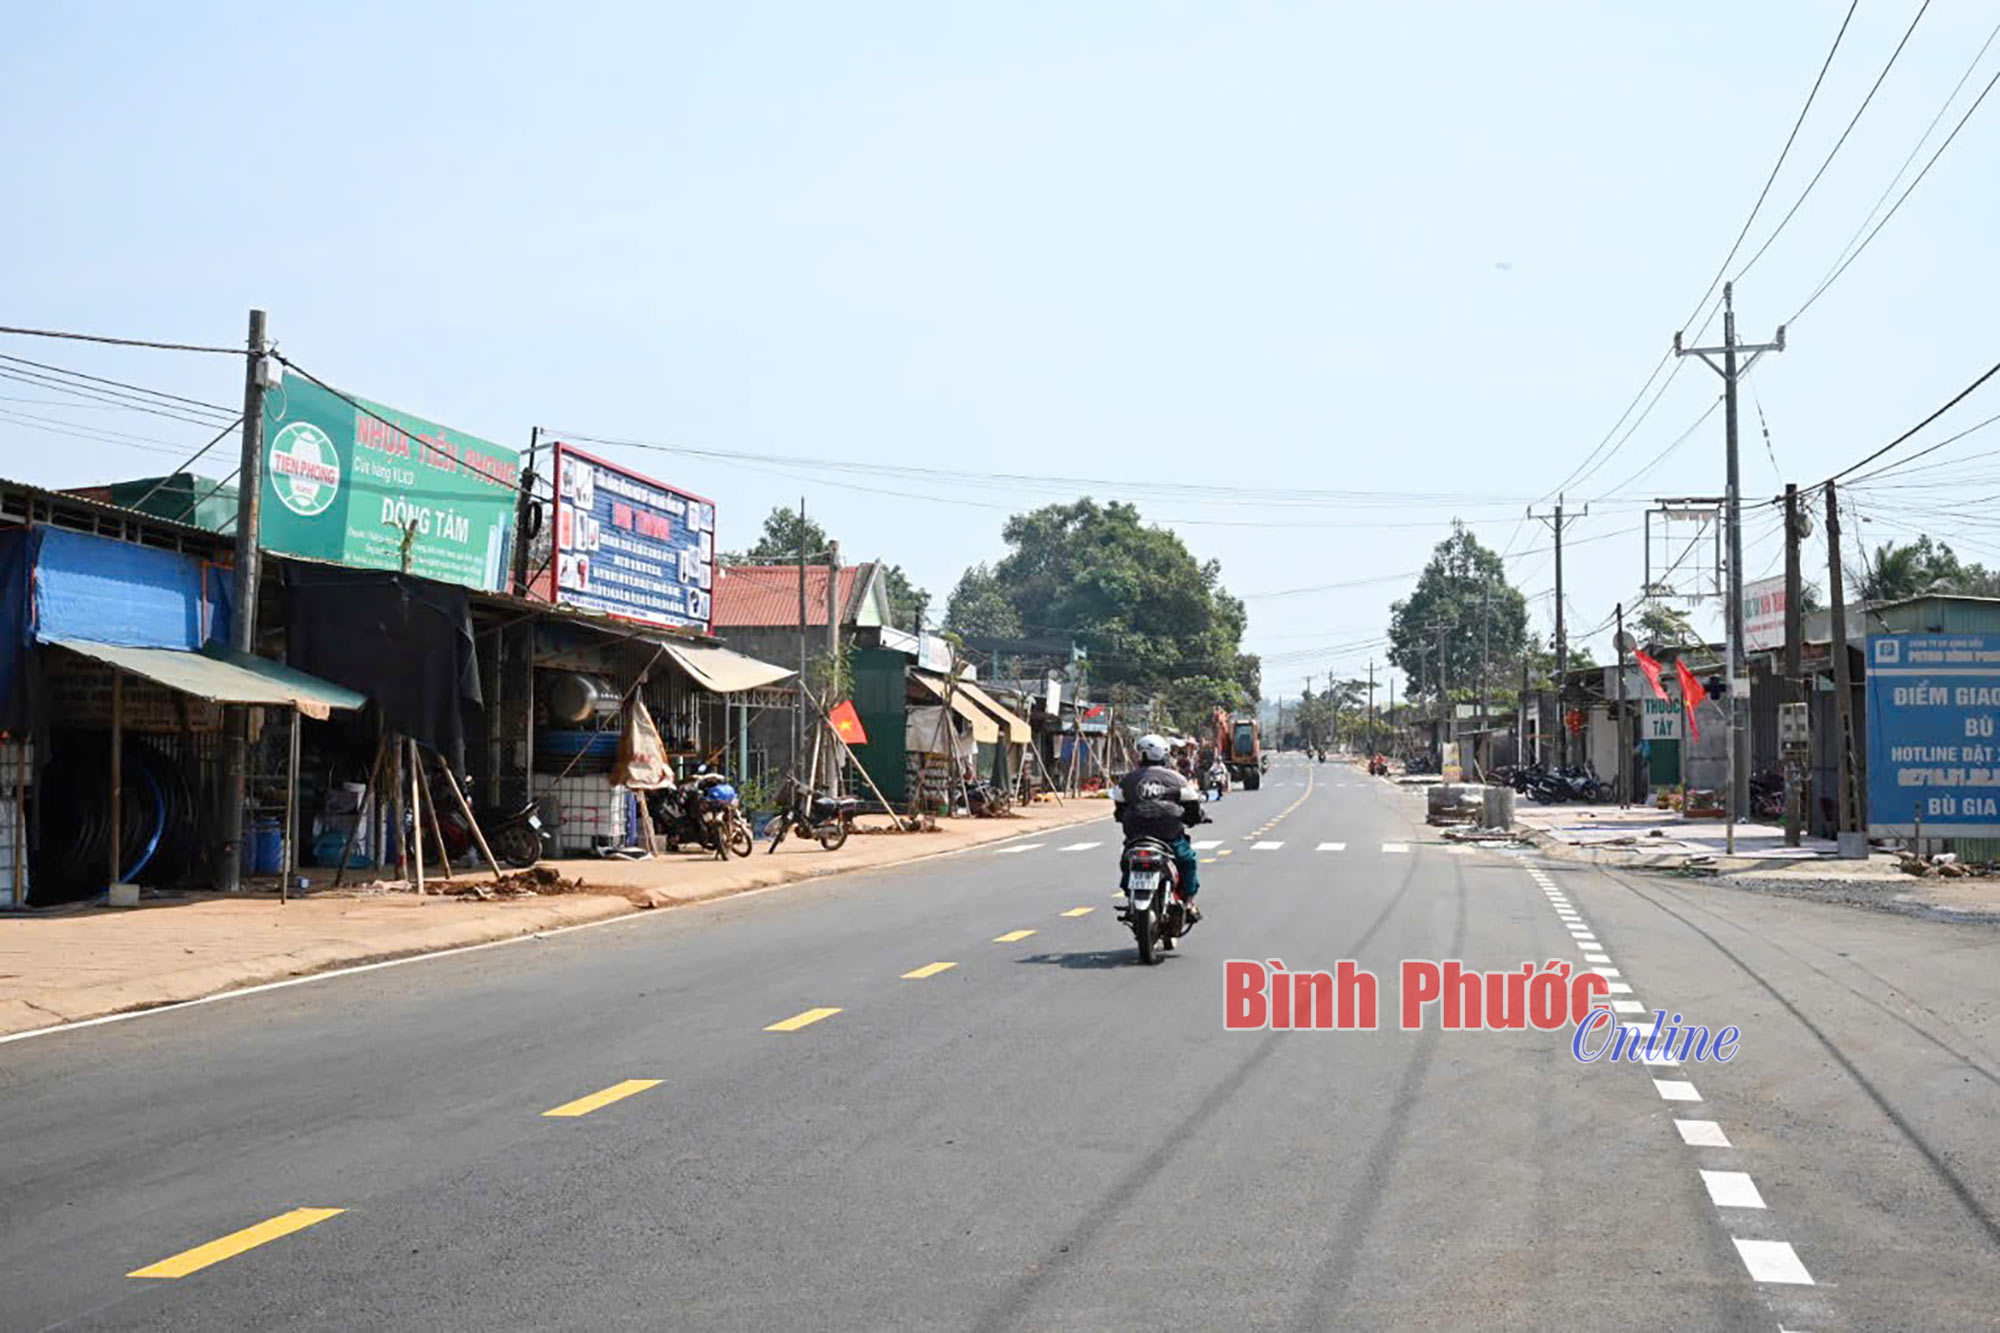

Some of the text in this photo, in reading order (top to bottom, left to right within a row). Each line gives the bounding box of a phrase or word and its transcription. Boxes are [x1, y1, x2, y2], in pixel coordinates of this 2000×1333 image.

[300, 459, 337, 485] PHONG
[1894, 679, 1949, 706] ĐIỂM
[1891, 746, 1958, 762] HOTLINE
[1928, 793, 1998, 816] BÙ GIA
